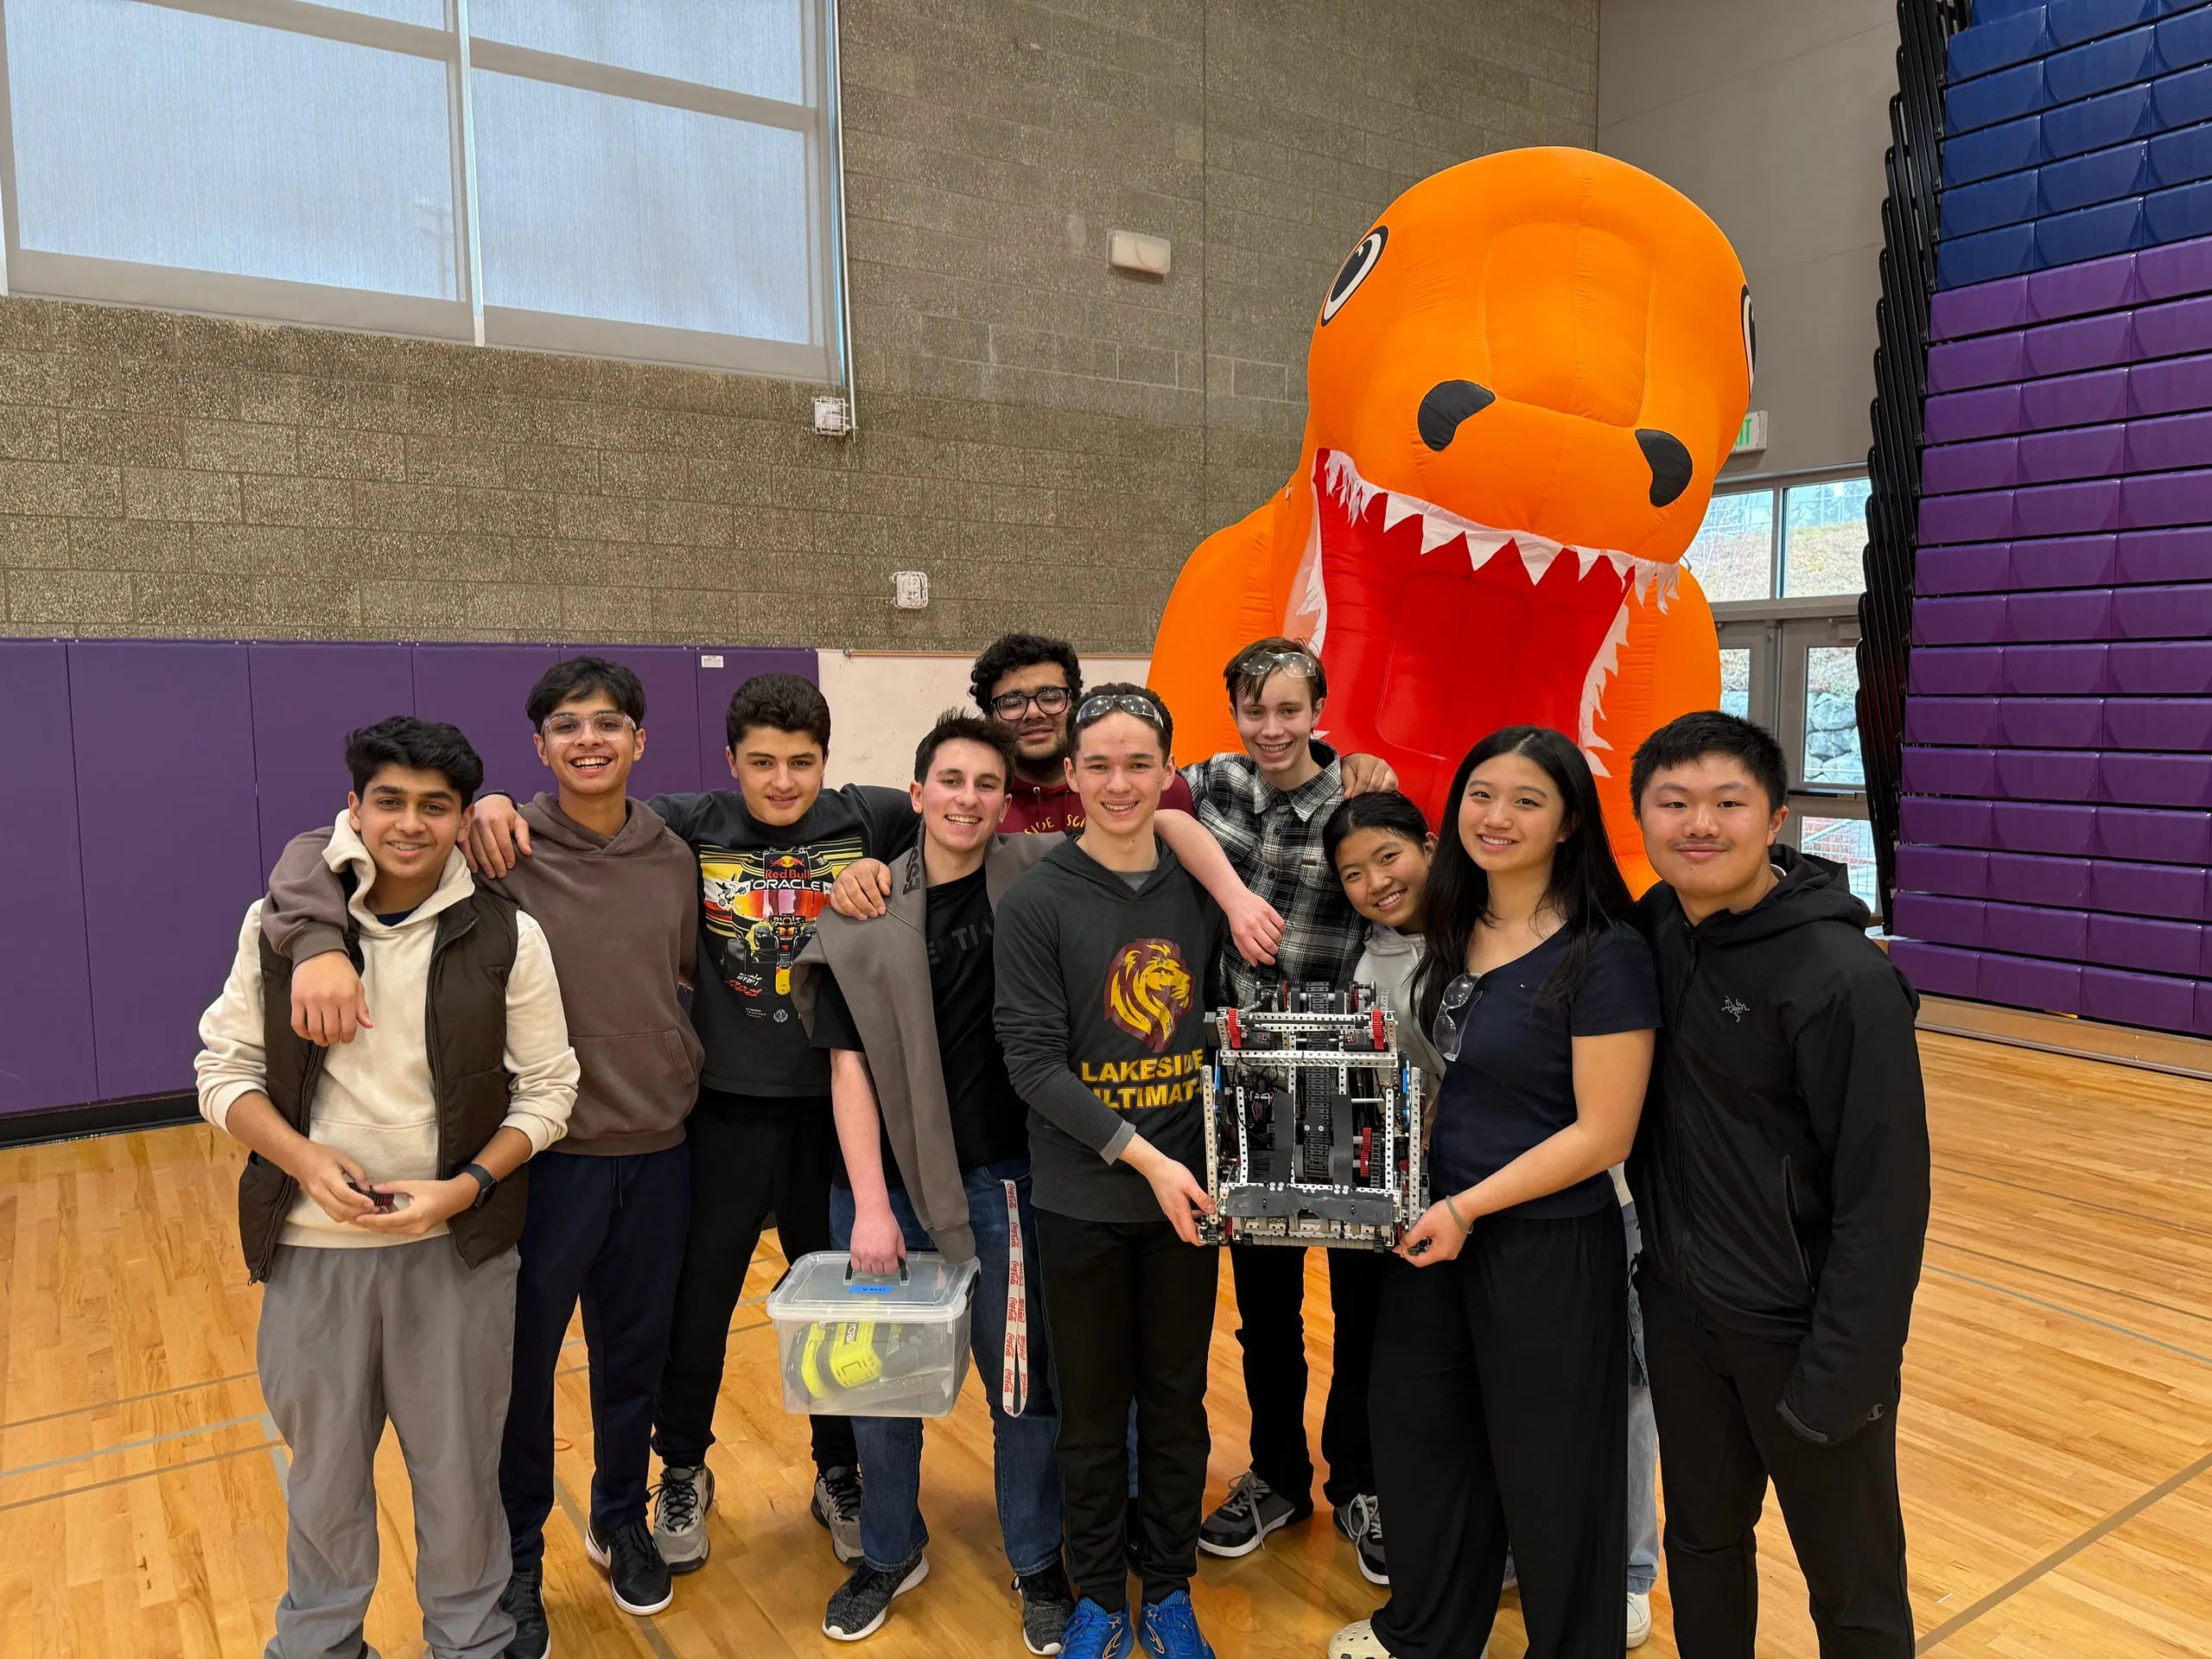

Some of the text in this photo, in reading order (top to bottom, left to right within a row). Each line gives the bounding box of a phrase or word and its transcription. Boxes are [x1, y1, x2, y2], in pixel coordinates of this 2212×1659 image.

[1735, 418, 1752, 446] IT
[1024, 817, 1054, 835] SIDE
[765, 869, 810, 880] Red Bull
[753, 879, 821, 892] ORACLE
[1081, 1048, 1204, 1082] LAKESIDE
